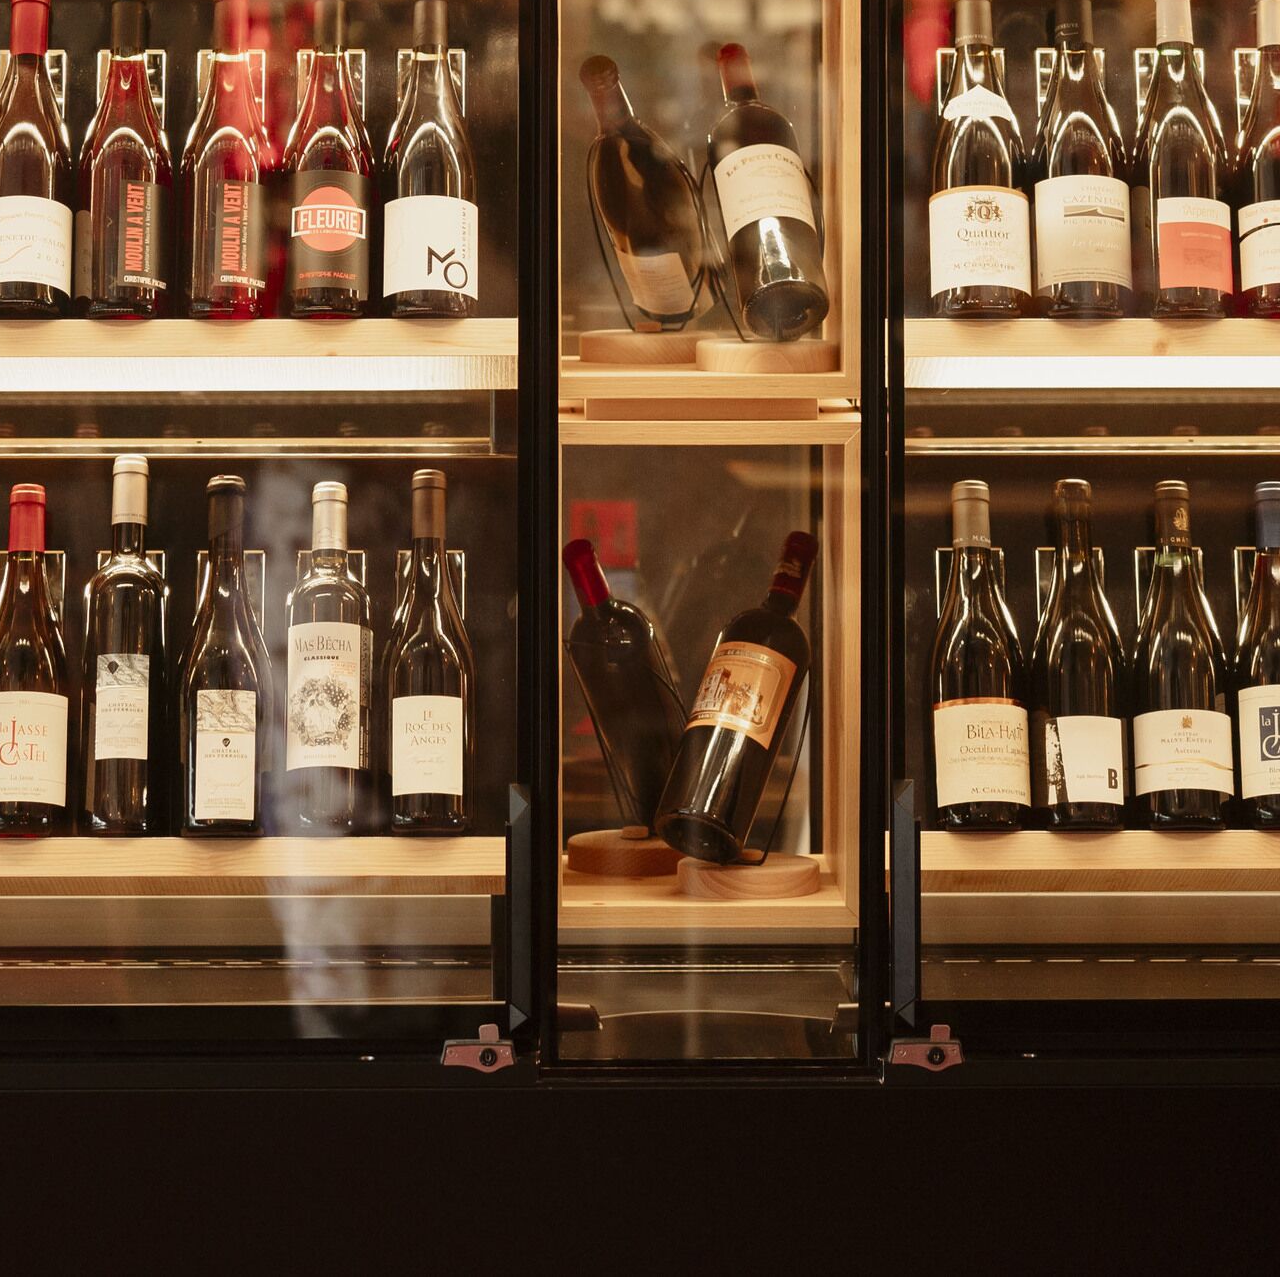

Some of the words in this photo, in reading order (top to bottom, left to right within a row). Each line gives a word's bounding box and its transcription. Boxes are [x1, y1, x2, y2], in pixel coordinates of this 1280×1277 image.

[126, 182, 145, 213] VENT
[223, 182, 242, 213] VENT
[126, 216, 144, 224] A
[223, 216, 241, 224] A
[300, 208, 358, 231] FLEURIE
[956, 229, 1011, 242] Quatuor
[124, 227, 144, 272] MOULIN
[221, 227, 241, 272] MOULIN
[294, 639, 315, 653] MAS
[316, 634, 353, 653] BÉCHA
[303, 654, 340, 662] CLASSIQUE
[423, 709, 433, 722] LE
[1261, 716, 1271, 727] la
[405, 722, 429, 734] ROC
[0, 723, 8, 733] la
[5, 716, 48, 756] JASSE
[410, 734, 448, 747] ANGES
[959, 745, 1004, 755] Occultum
[1107, 768, 1119, 789] B
